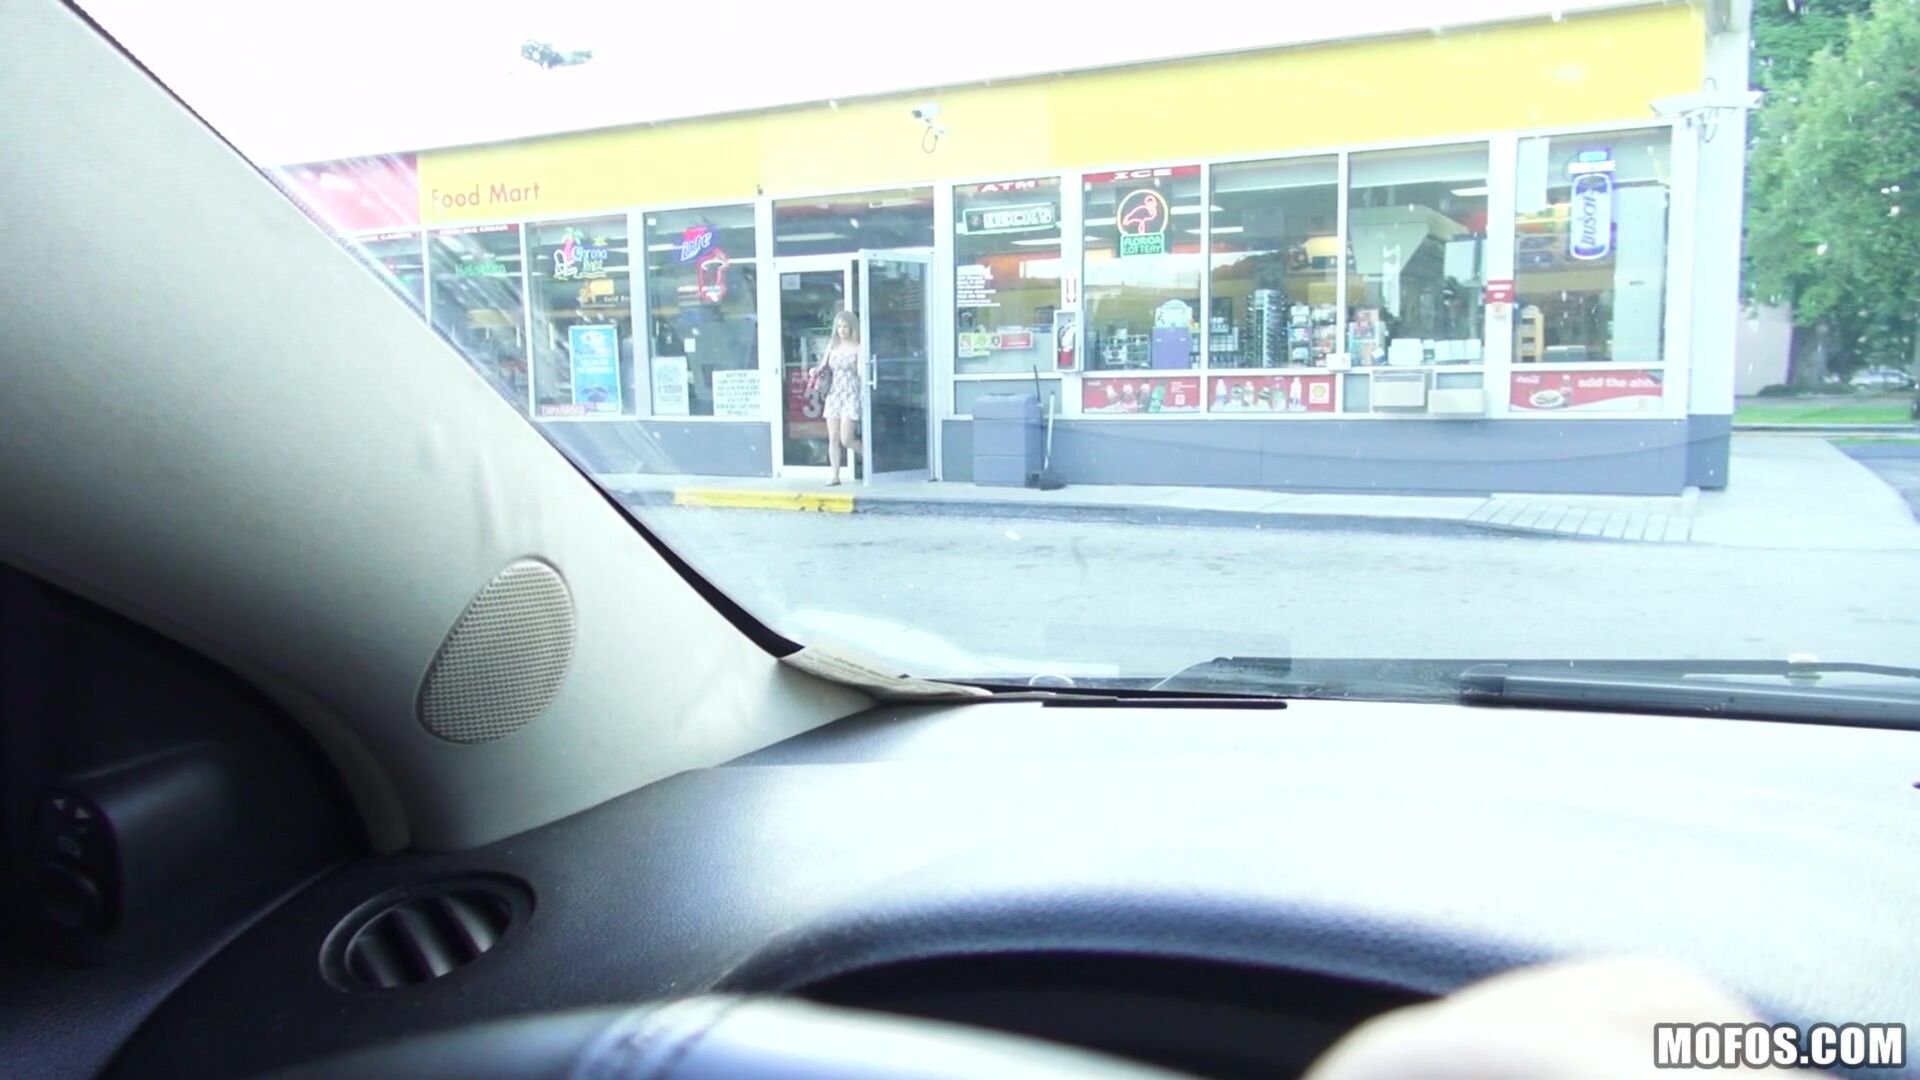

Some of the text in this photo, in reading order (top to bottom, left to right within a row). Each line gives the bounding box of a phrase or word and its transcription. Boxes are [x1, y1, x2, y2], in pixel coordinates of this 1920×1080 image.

[1114, 168, 1172, 182] ICE
[980, 180, 1036, 192] ATM
[431, 181, 540, 208] Food Mart
[1123, 235, 1162, 247] FLORIDA
[1123, 244, 1162, 255] LOTTERY
[1577, 377, 1604, 388] add
[1605, 377, 1627, 388] the
